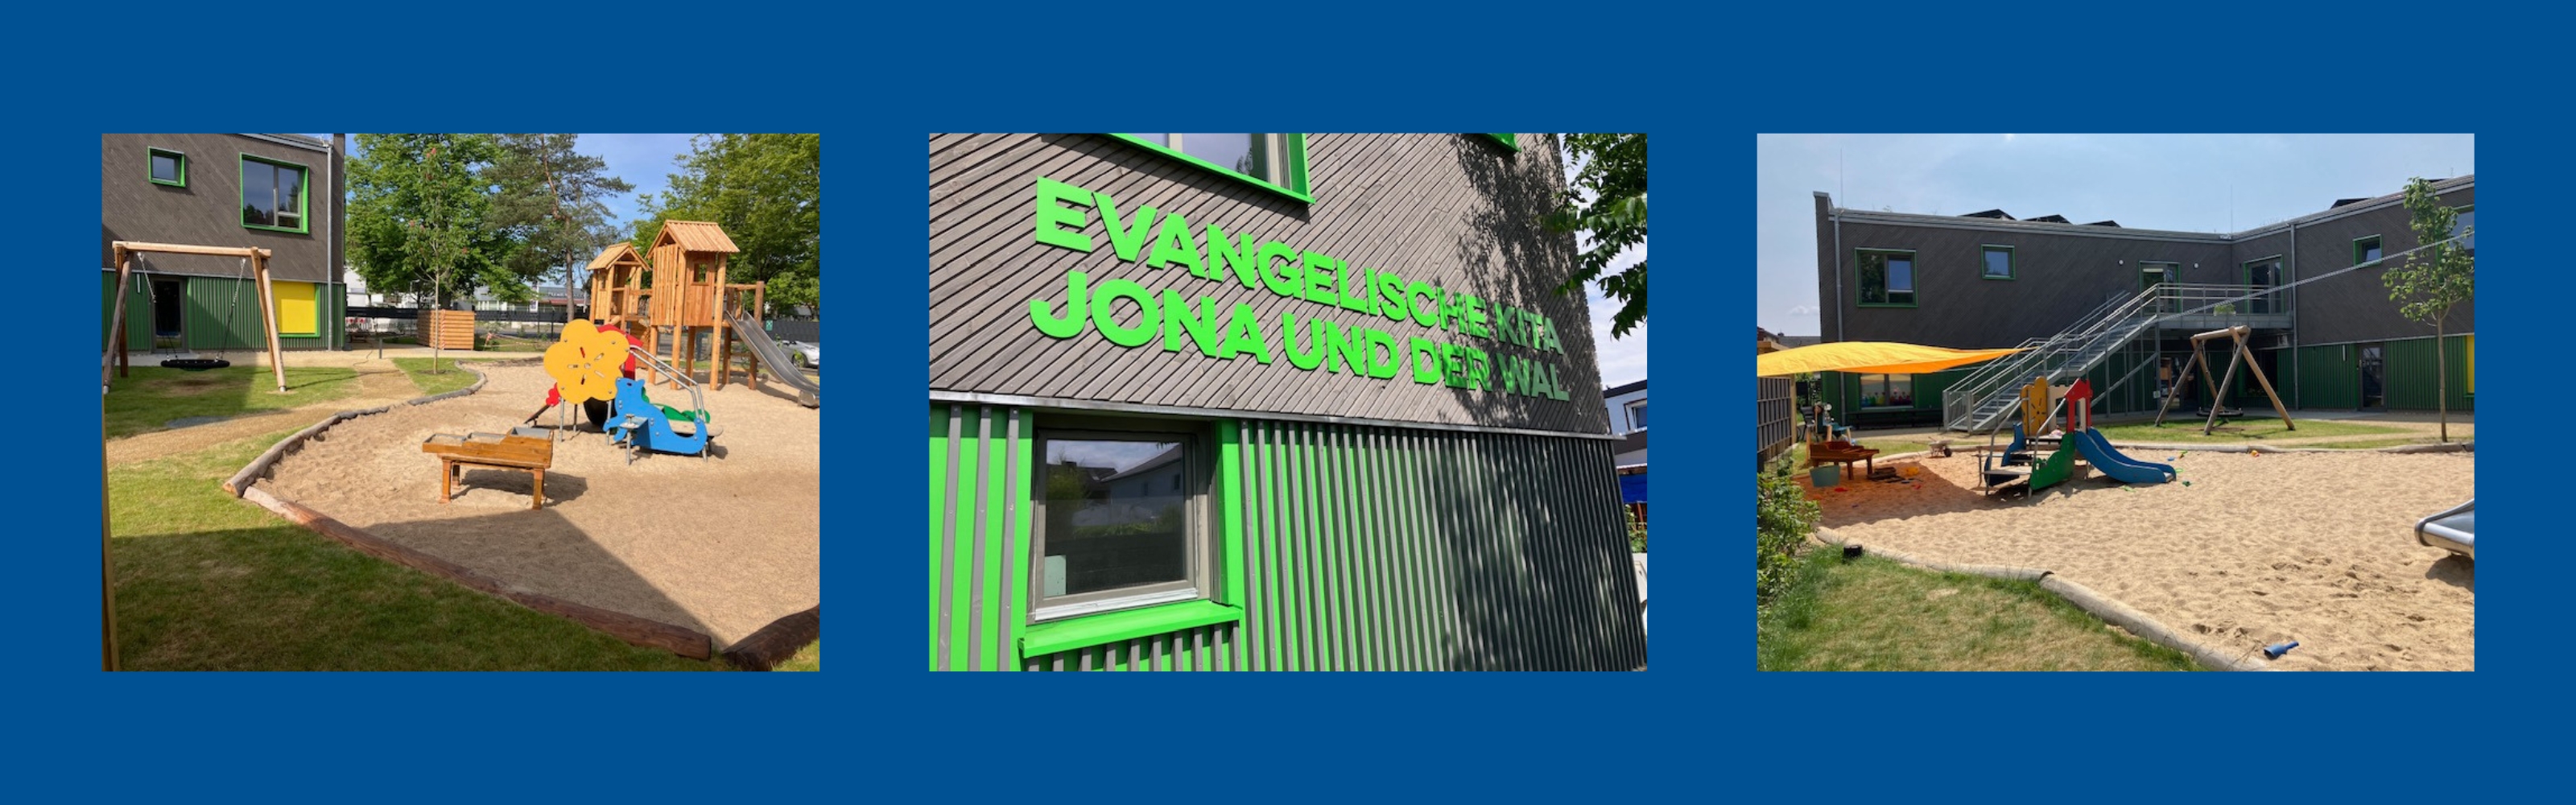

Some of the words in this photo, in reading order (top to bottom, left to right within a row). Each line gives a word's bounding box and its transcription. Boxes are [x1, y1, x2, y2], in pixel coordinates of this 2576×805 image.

[1030, 270, 1271, 365] JONA
[1282, 312, 1399, 378] UND
[1410, 336, 1492, 392] DER
[1496, 352, 1570, 402] WAL
[1035, 176, 1489, 339] EVANGELISCHE
[1494, 302, 1563, 355] KITA
